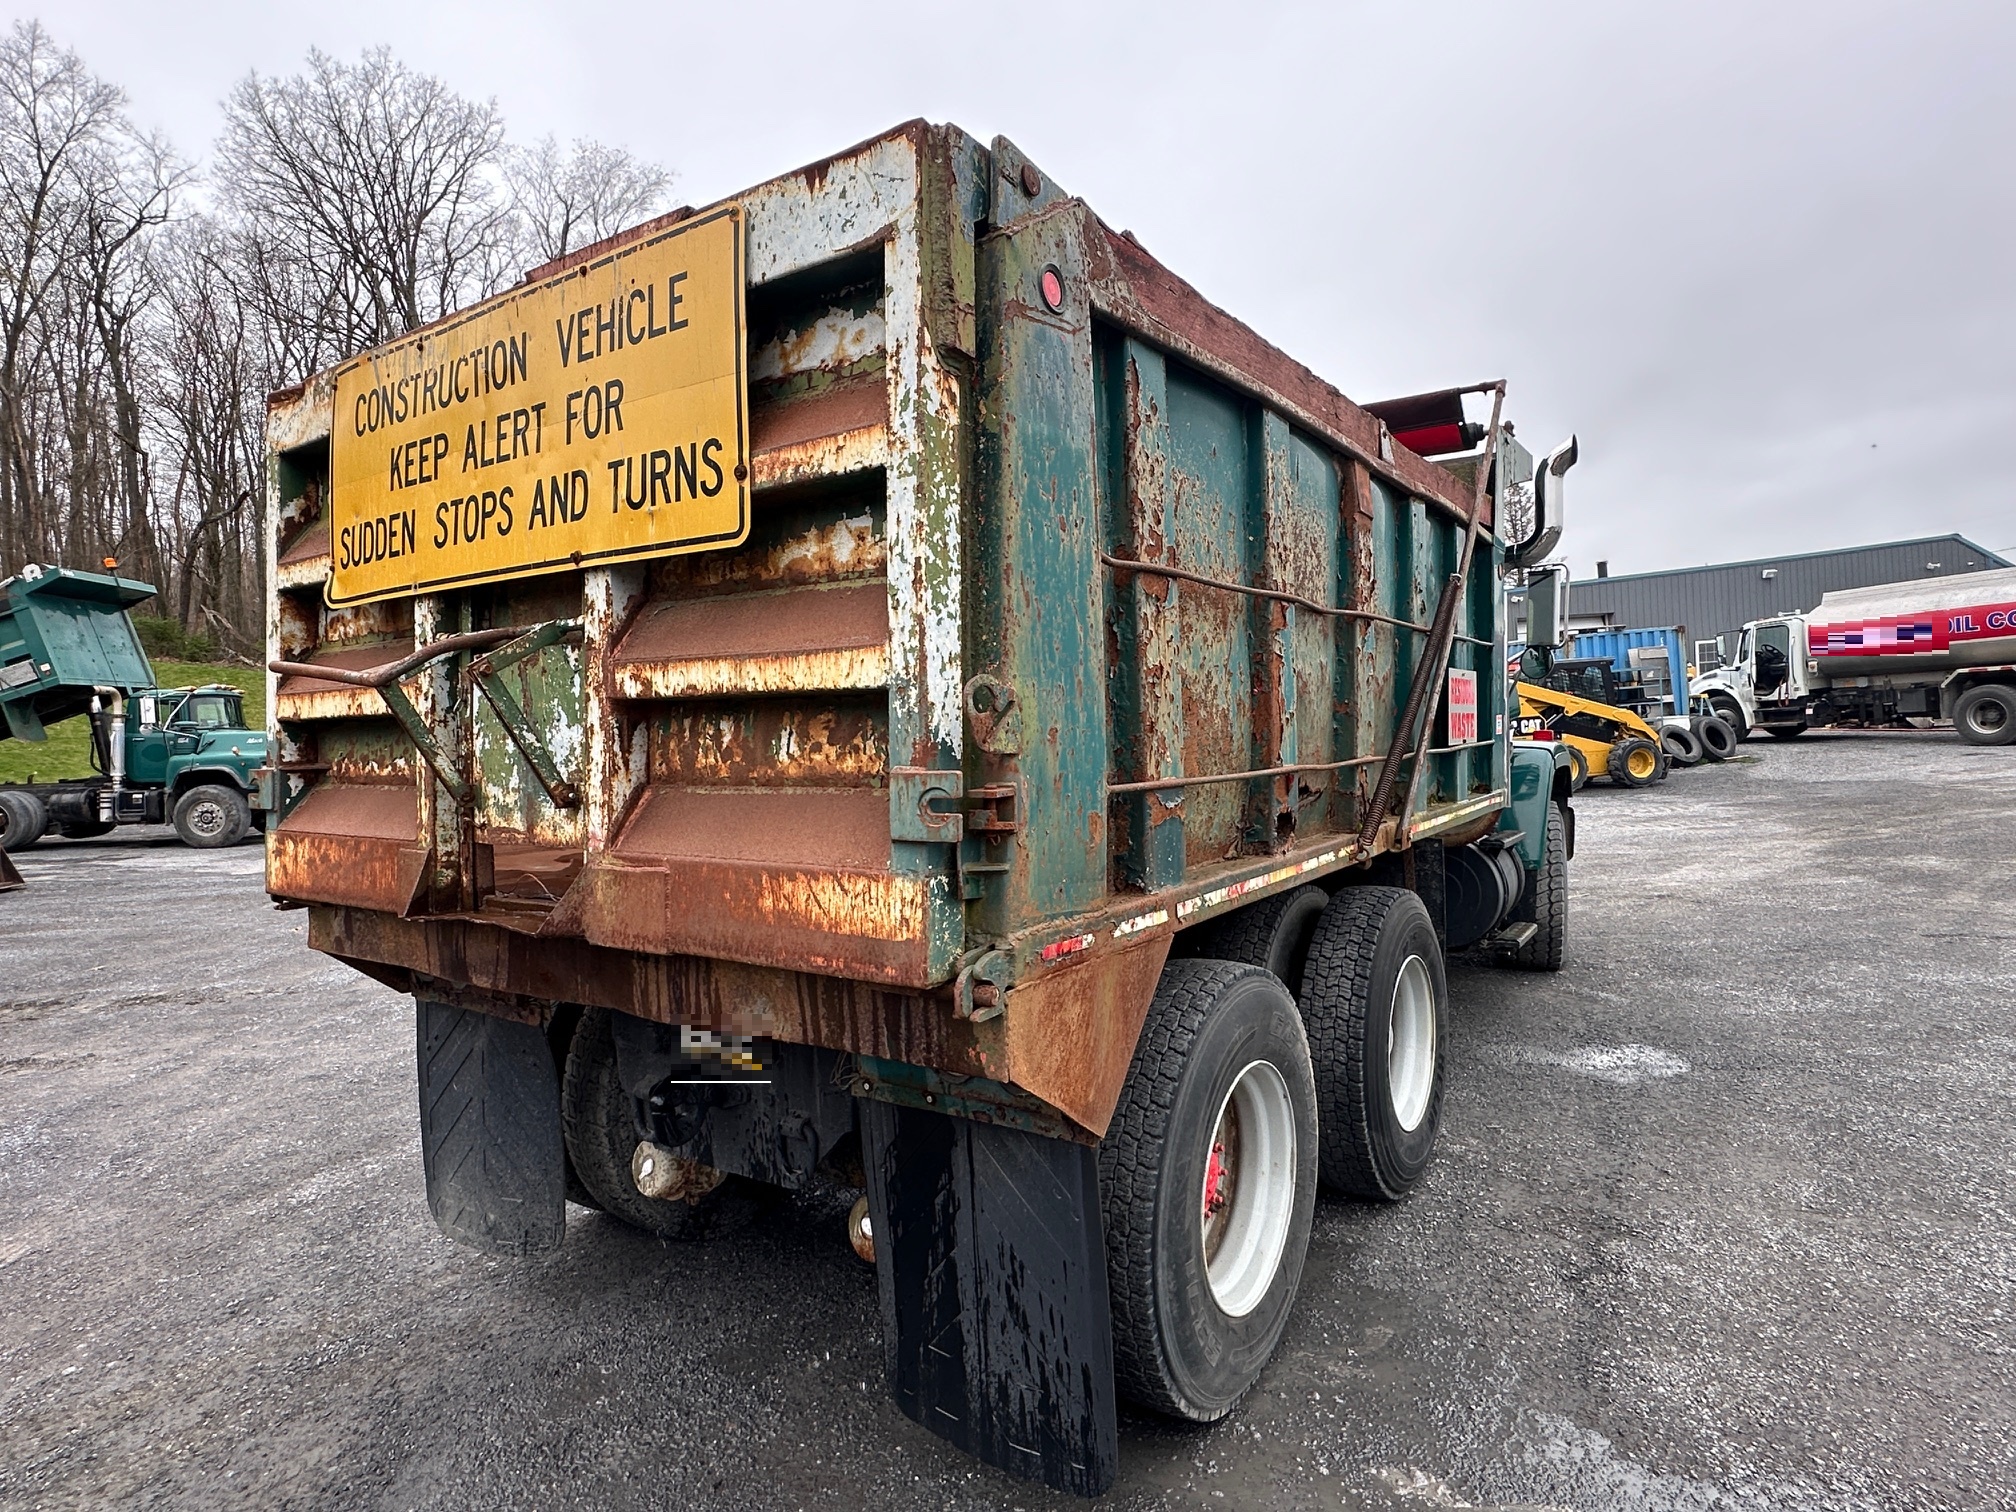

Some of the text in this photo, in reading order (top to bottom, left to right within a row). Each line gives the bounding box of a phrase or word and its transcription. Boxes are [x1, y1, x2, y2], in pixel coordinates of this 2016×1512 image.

[355, 271, 689, 438] CONSTRUCTION VEHICLE
[390, 378, 624, 492] KEEP ALERT FOR
[339, 437, 724, 571] SUDDEN STOPS AND TURNS
[1949, 614, 1980, 634] IL
[1451, 712, 1475, 739] WASTE
[1520, 718, 1542, 734] CAT
